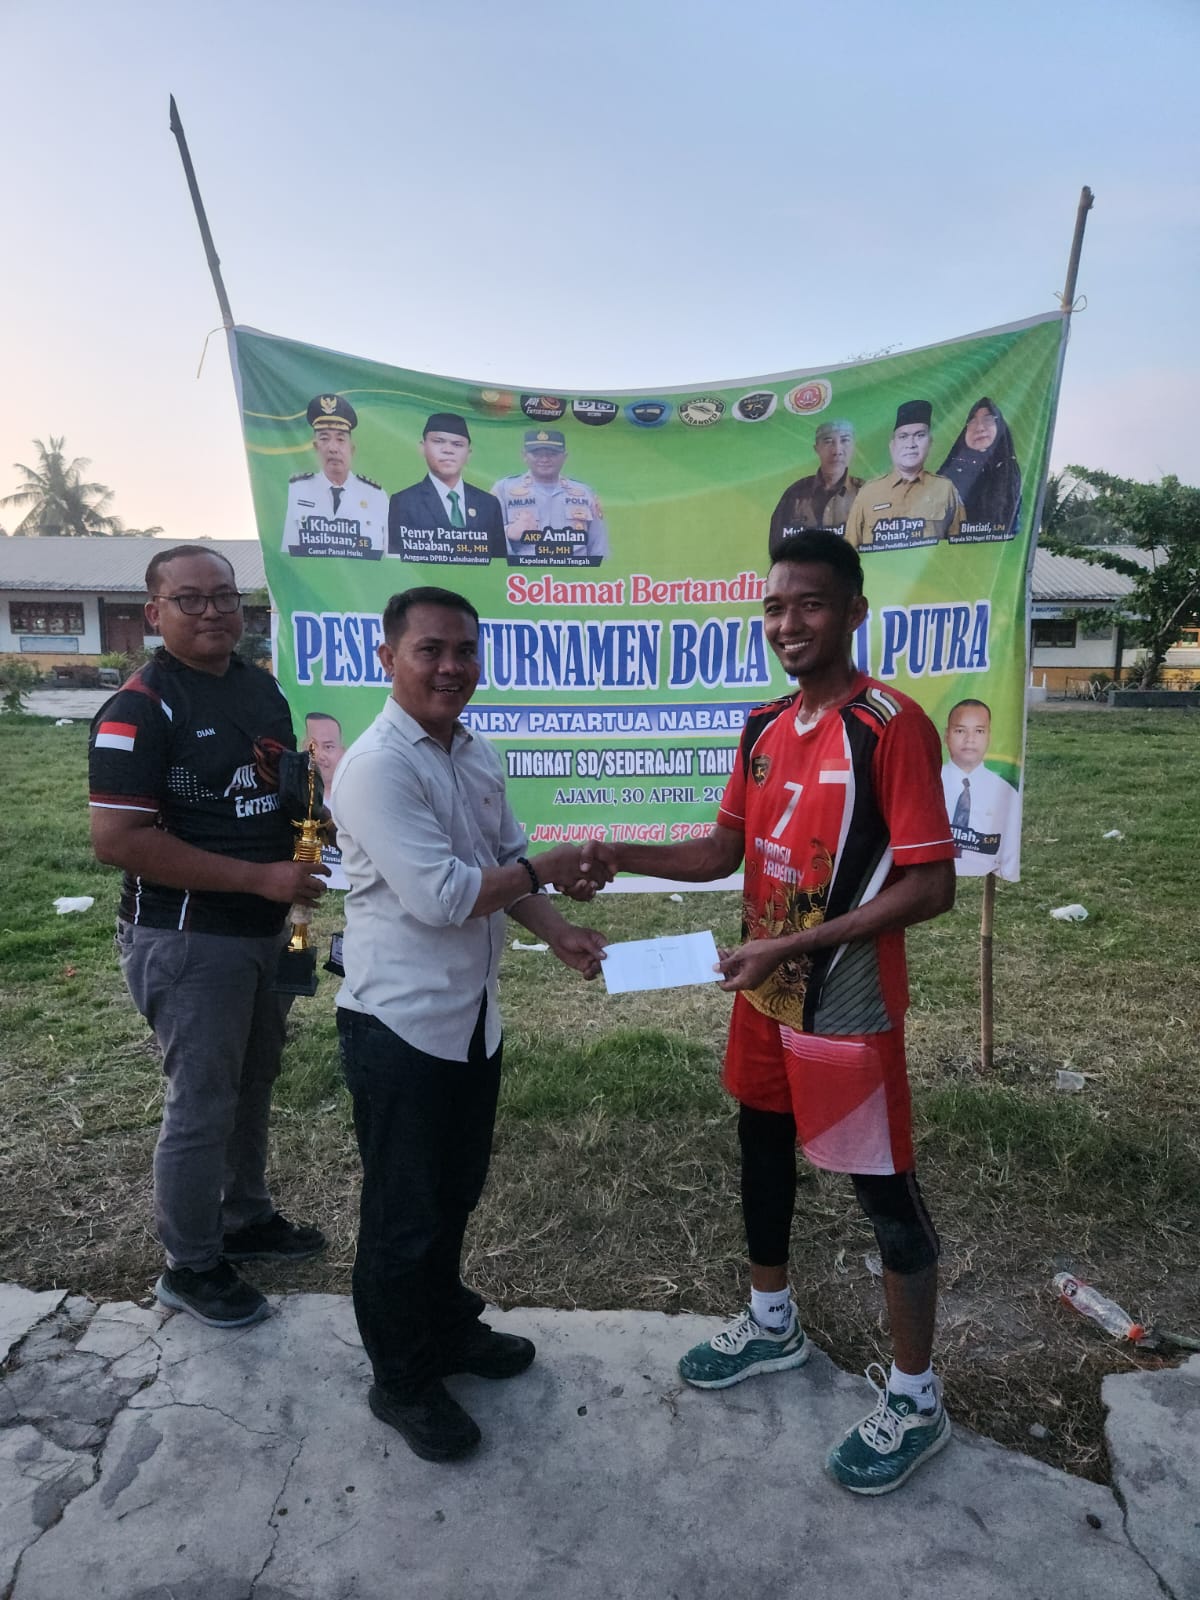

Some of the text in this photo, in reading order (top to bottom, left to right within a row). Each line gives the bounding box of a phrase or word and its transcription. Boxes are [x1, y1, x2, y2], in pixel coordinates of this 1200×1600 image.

[684, 413, 718, 425] BRANDED
[310, 519, 357, 534] Khoilid
[400, 525, 488, 540] Penry Patartua
[873, 519, 924, 532] Abdi Jaya
[301, 532, 369, 548] Hasibuan, SE
[524, 530, 585, 542] AKP Amlan
[875, 530, 921, 541] Pohan, SH
[402, 539, 454, 553] Nababan,
[474, 545, 488, 553] MH
[555, 546, 571, 554] MH
[508, 575, 624, 604] Selamat
[294, 615, 391, 683] PESE
[670, 620, 769, 685] BOLA
[881, 604, 988, 676] PUTRA
[529, 712, 651, 731] PATARTUA
[196, 728, 216, 738] DIAN
[507, 751, 572, 776] TINGKAT
[576, 749, 693, 778] SD/SEDERAJAT
[553, 789, 617, 806] AJAMU,
[622, 789, 644, 803] 30
[649, 787, 699, 803] APRIL
[235, 793, 280, 818] ENTERT
[771, 781, 803, 839] 7
[530, 824, 607, 842] JUNJUNG
[610, 824, 666, 842] TINGGI
